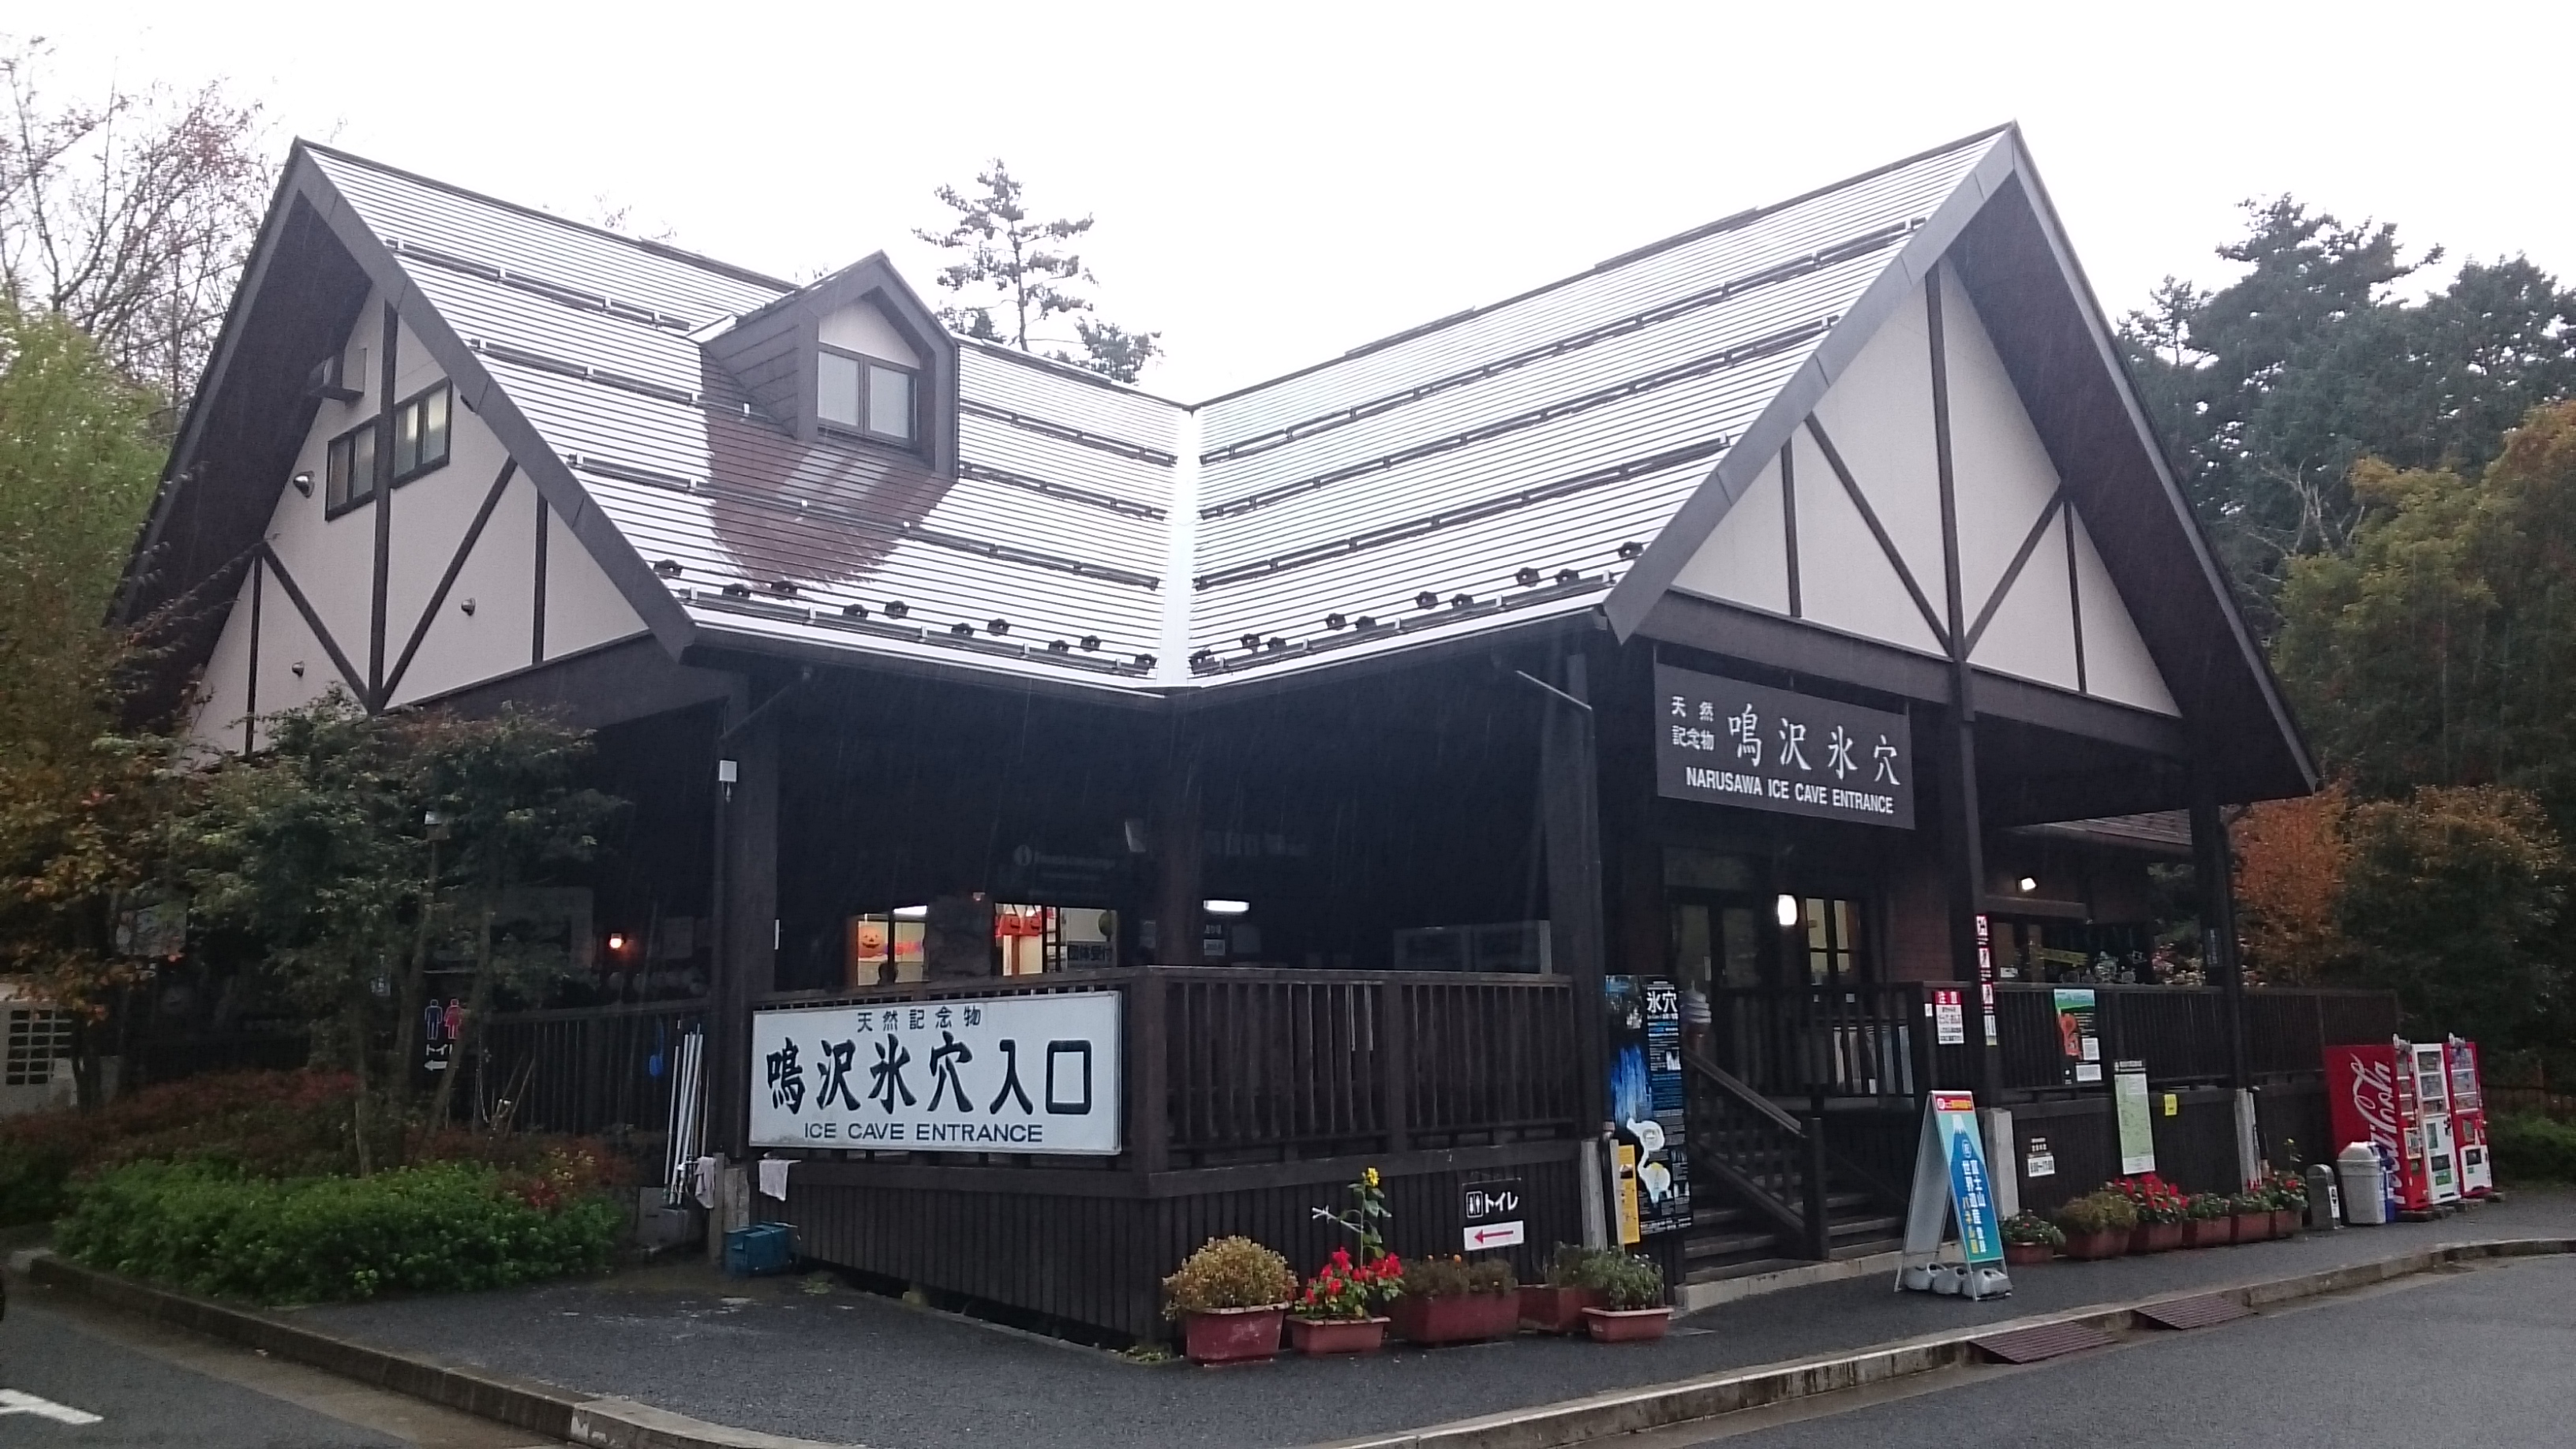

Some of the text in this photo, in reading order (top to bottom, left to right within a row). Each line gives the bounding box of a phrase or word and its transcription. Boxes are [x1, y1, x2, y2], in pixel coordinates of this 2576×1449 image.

[1671, 695, 1714, 722] 天然
[1671, 724, 1715, 751] 記念物
[1727, 702, 1901, 786] 鳴沢氷穴
[1685, 766, 1894, 814] NARUSAWA ICE CAVE ENTRANCE
[1646, 990, 1678, 1013] 氷穴
[857, 1005, 982, 1033] 天然記念物
[765, 1031, 1092, 1116] 鳴沢氷穴入口
[804, 1121, 1043, 1144] ICE CAVE ENTRANCE
[2349, 1053, 2406, 1204] oca-Cola
[1484, 1191, 1518, 1215] トイレ
